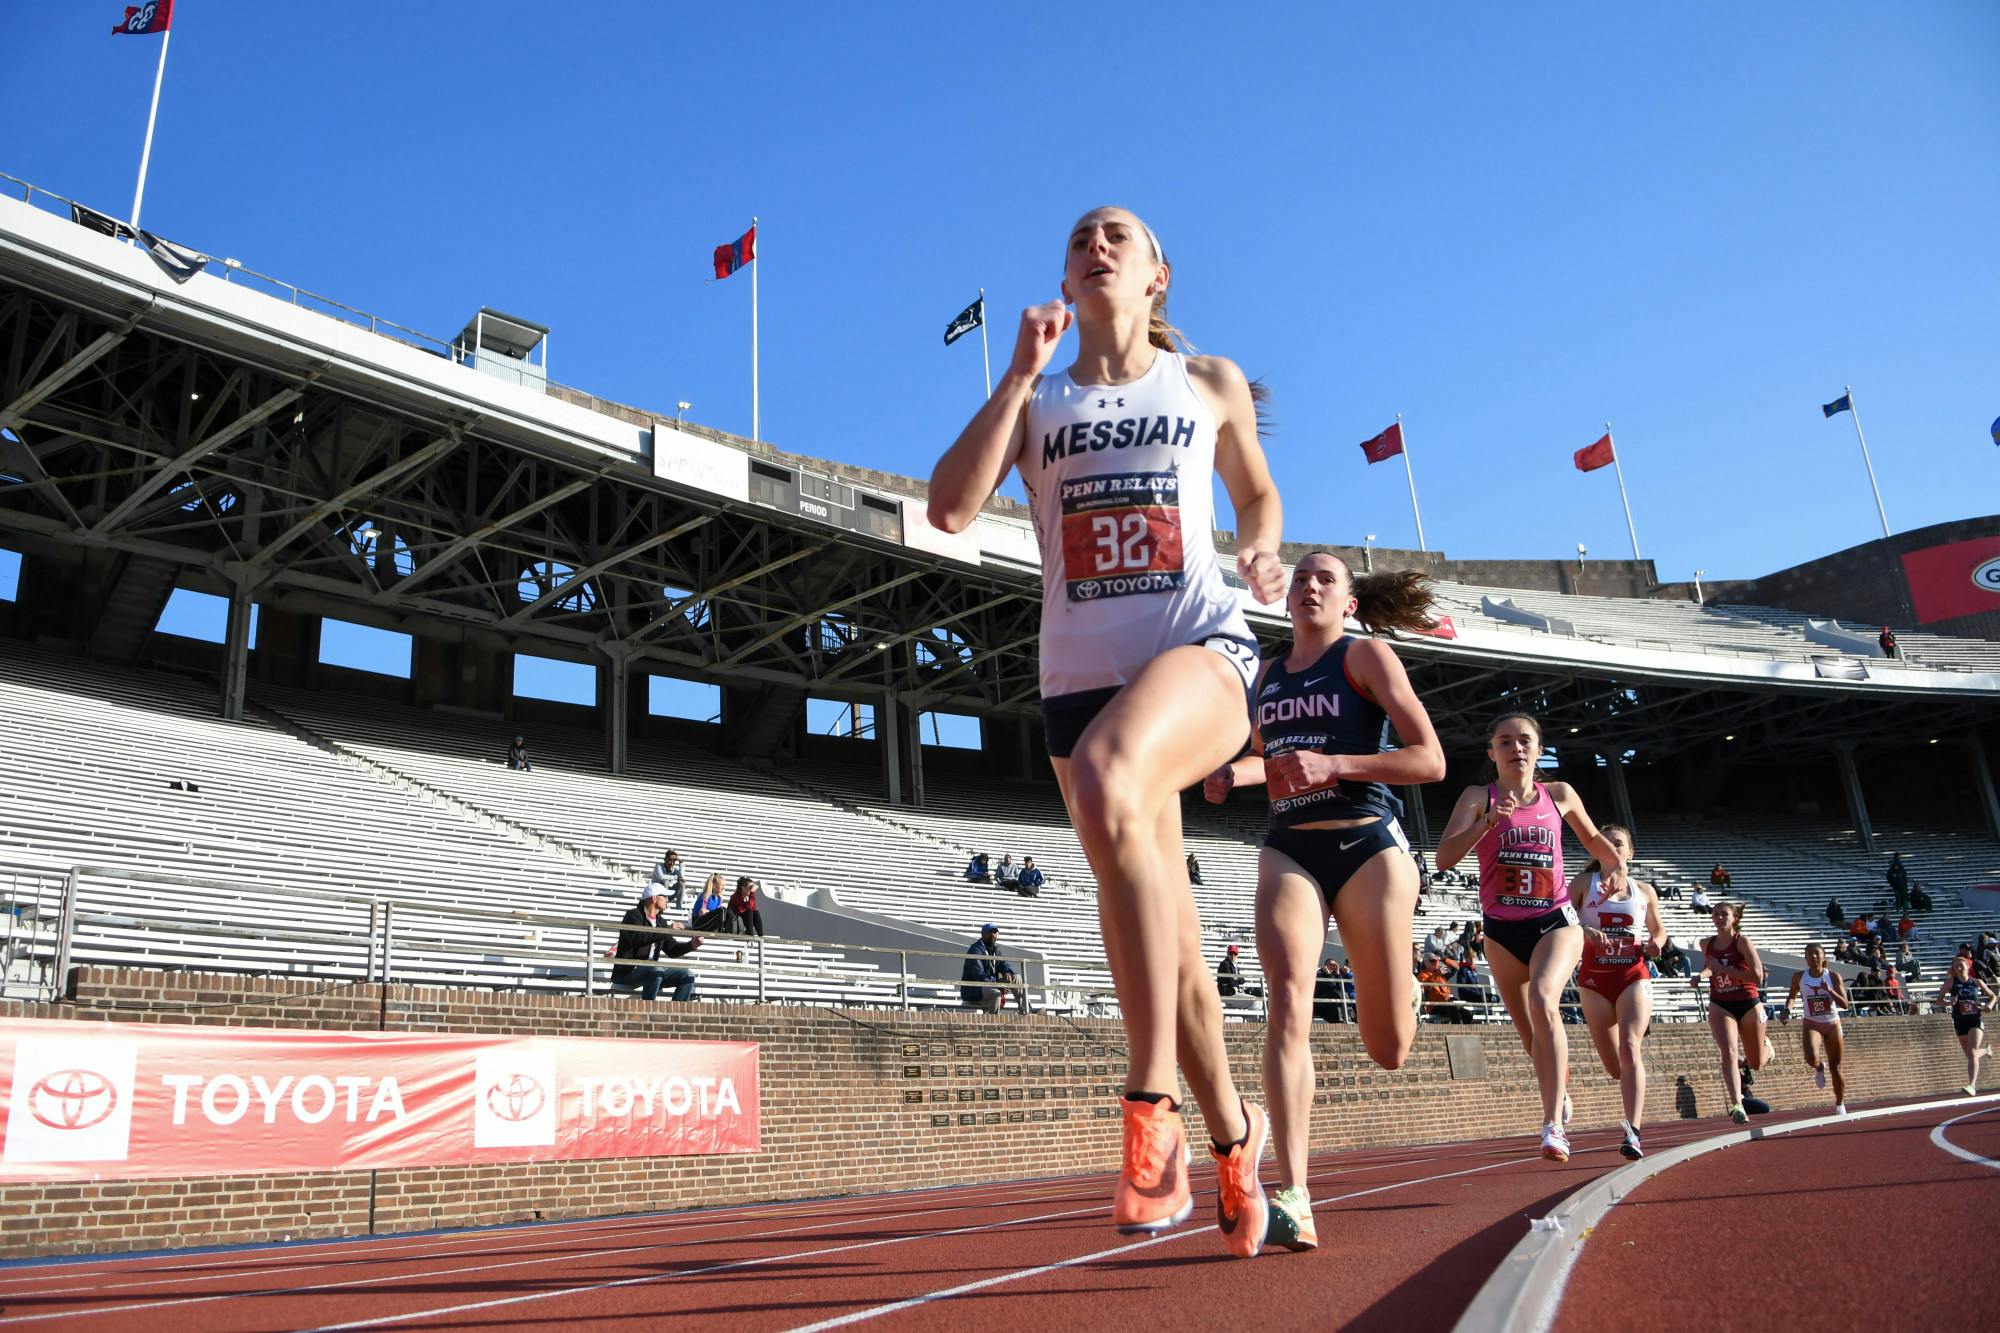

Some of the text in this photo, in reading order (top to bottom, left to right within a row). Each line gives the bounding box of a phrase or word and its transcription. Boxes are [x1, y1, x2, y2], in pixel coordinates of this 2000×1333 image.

[1042, 416, 1196, 470] MESSIAH
[1062, 477, 1177, 499] PENN RELAYS
[800, 500, 828, 517] PERIOD
[1091, 512, 1149, 572] 32
[1103, 575, 1173, 594] TOYOTA
[1264, 737, 1286, 752] PENN
[1286, 735, 1327, 744] RELAYS
[1291, 789, 1336, 808] TOYOTA
[1498, 826, 1556, 850] TOLEDO
[1498, 851, 1521, 859] PENN
[1516, 898, 1550, 907] TOYOTA
[1716, 974, 1732, 988] 34
[1813, 1001, 1825, 1012] 25
[162, 1074, 741, 1126] TOYOTA TOYOTA
